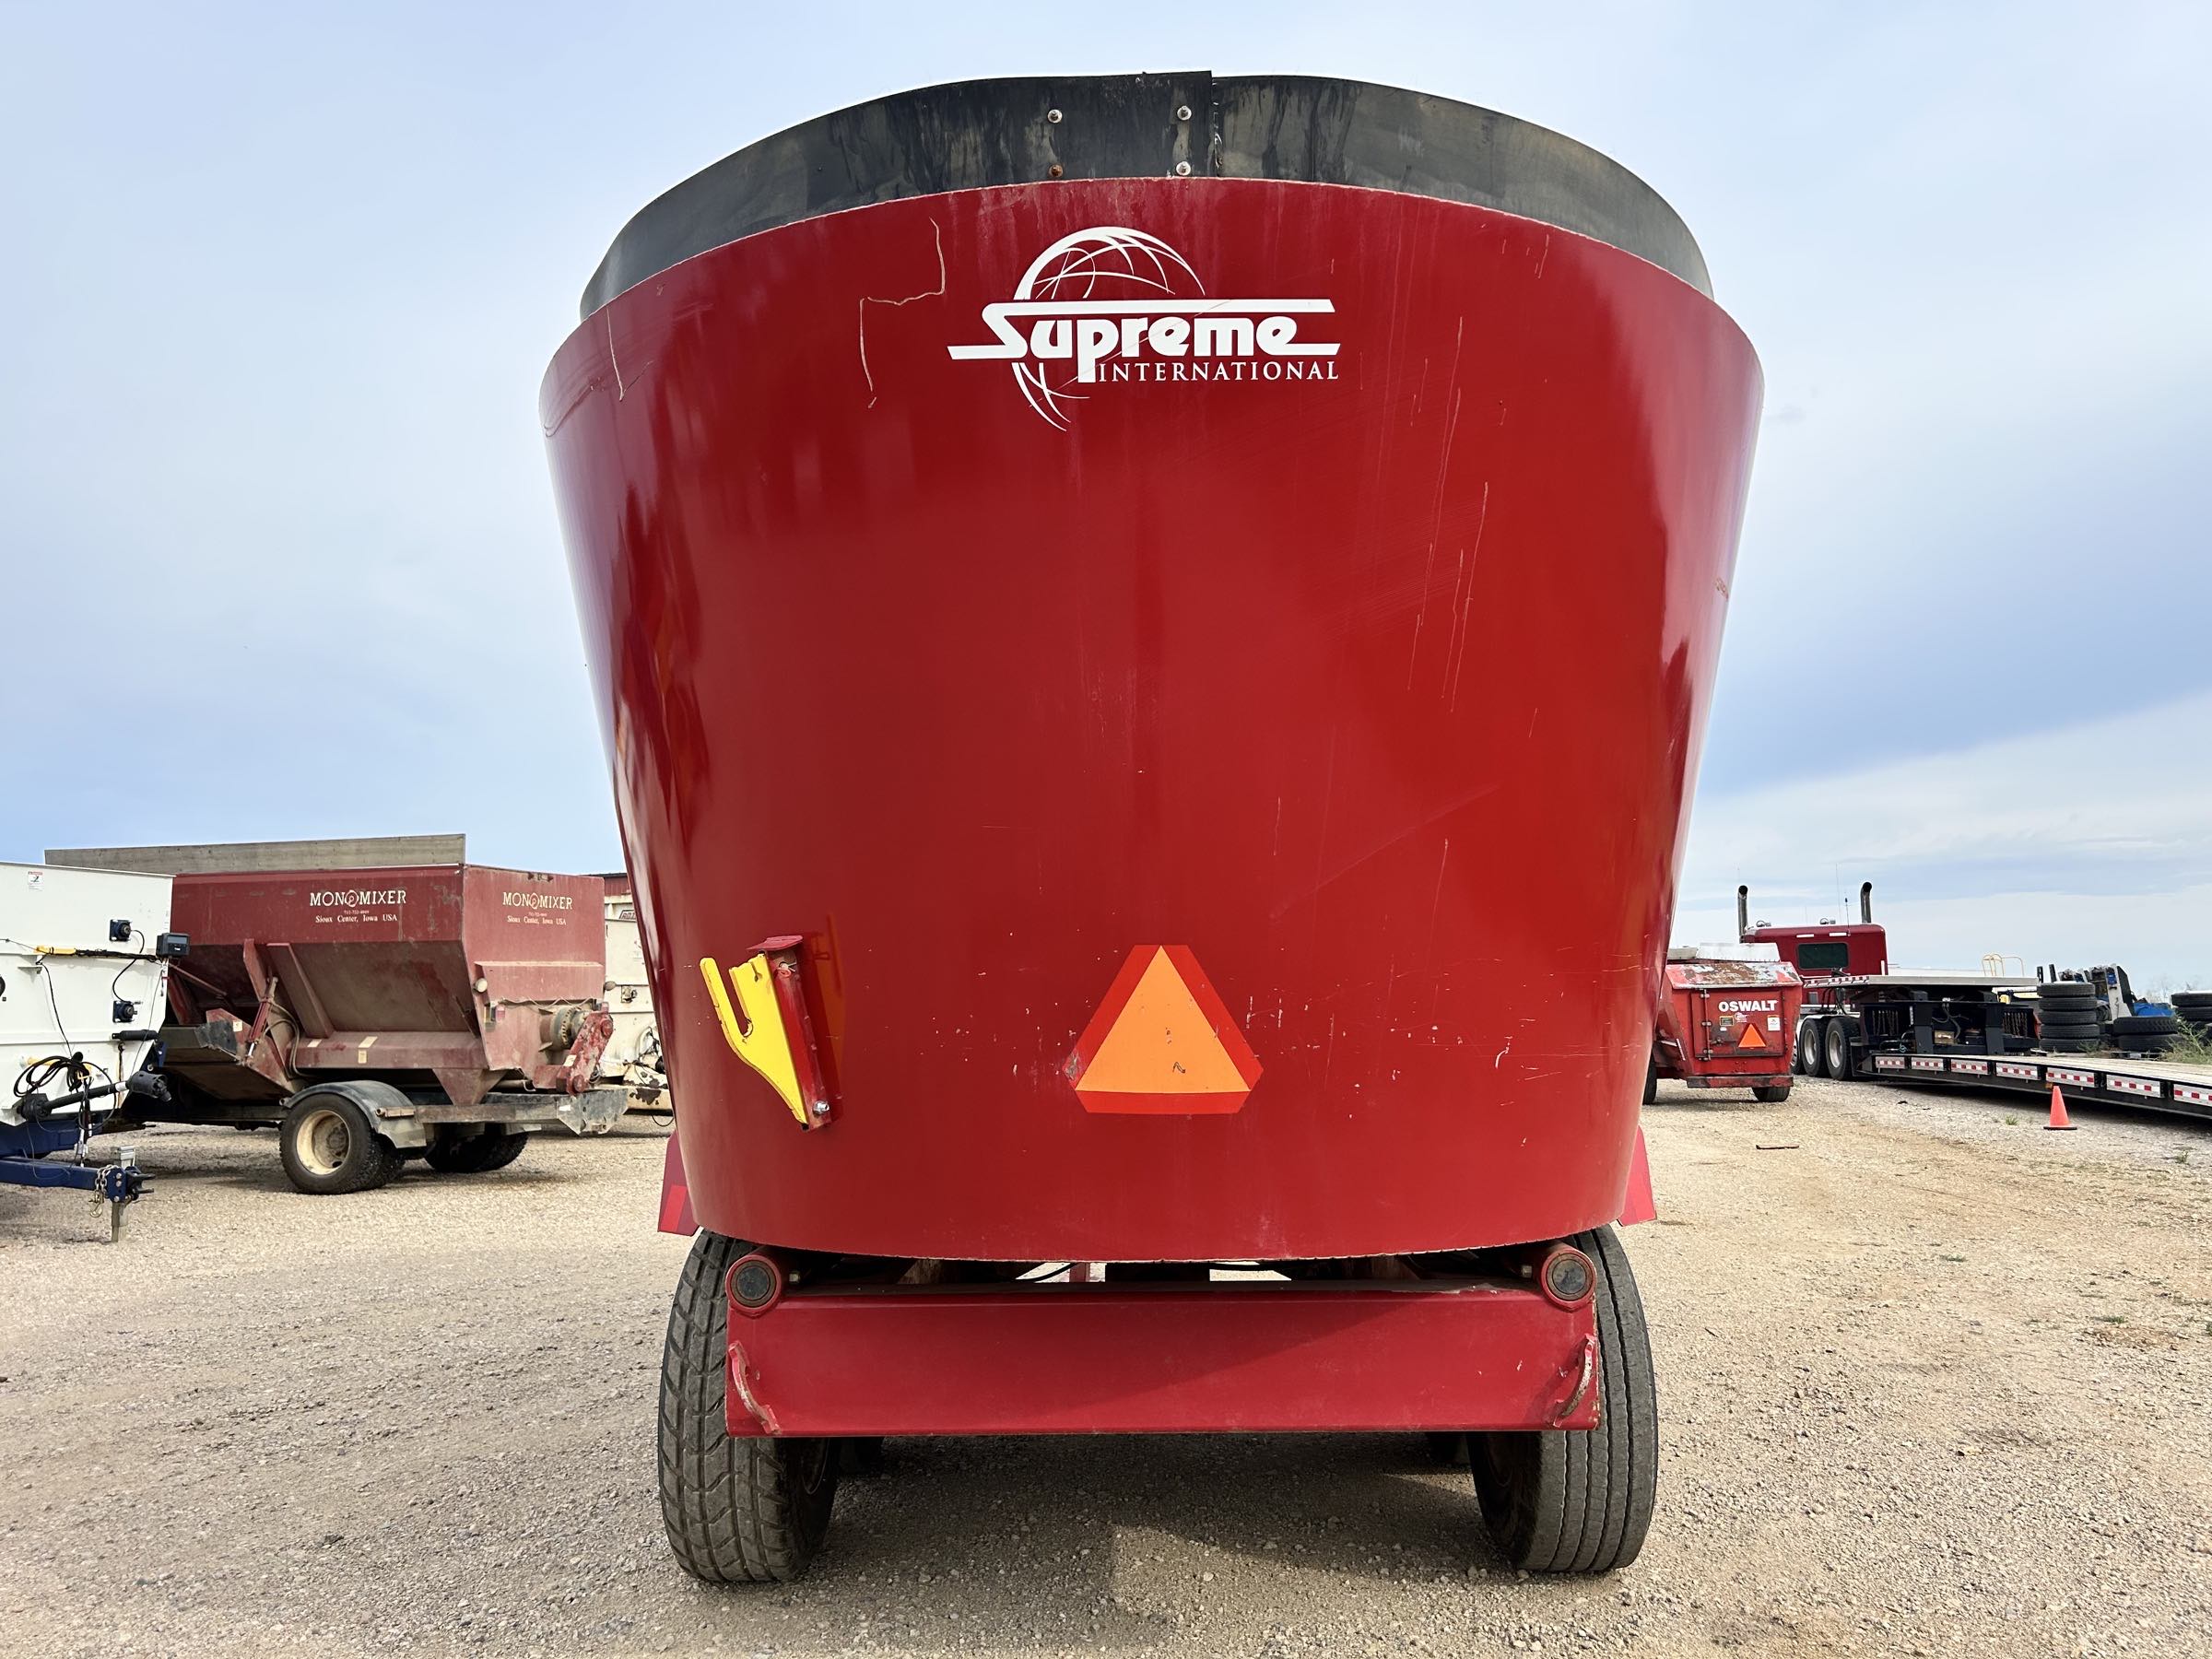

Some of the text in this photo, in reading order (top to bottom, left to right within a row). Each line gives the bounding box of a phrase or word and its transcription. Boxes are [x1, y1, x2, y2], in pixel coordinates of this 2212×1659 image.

[947, 299, 1341, 383] Supreme
[1099, 360, 1340, 382] INTERNATIONAL
[315, 915, 333, 924] Sioux
[382, 913, 397, 922] USA
[1718, 1000, 1780, 1012] OSWALT
